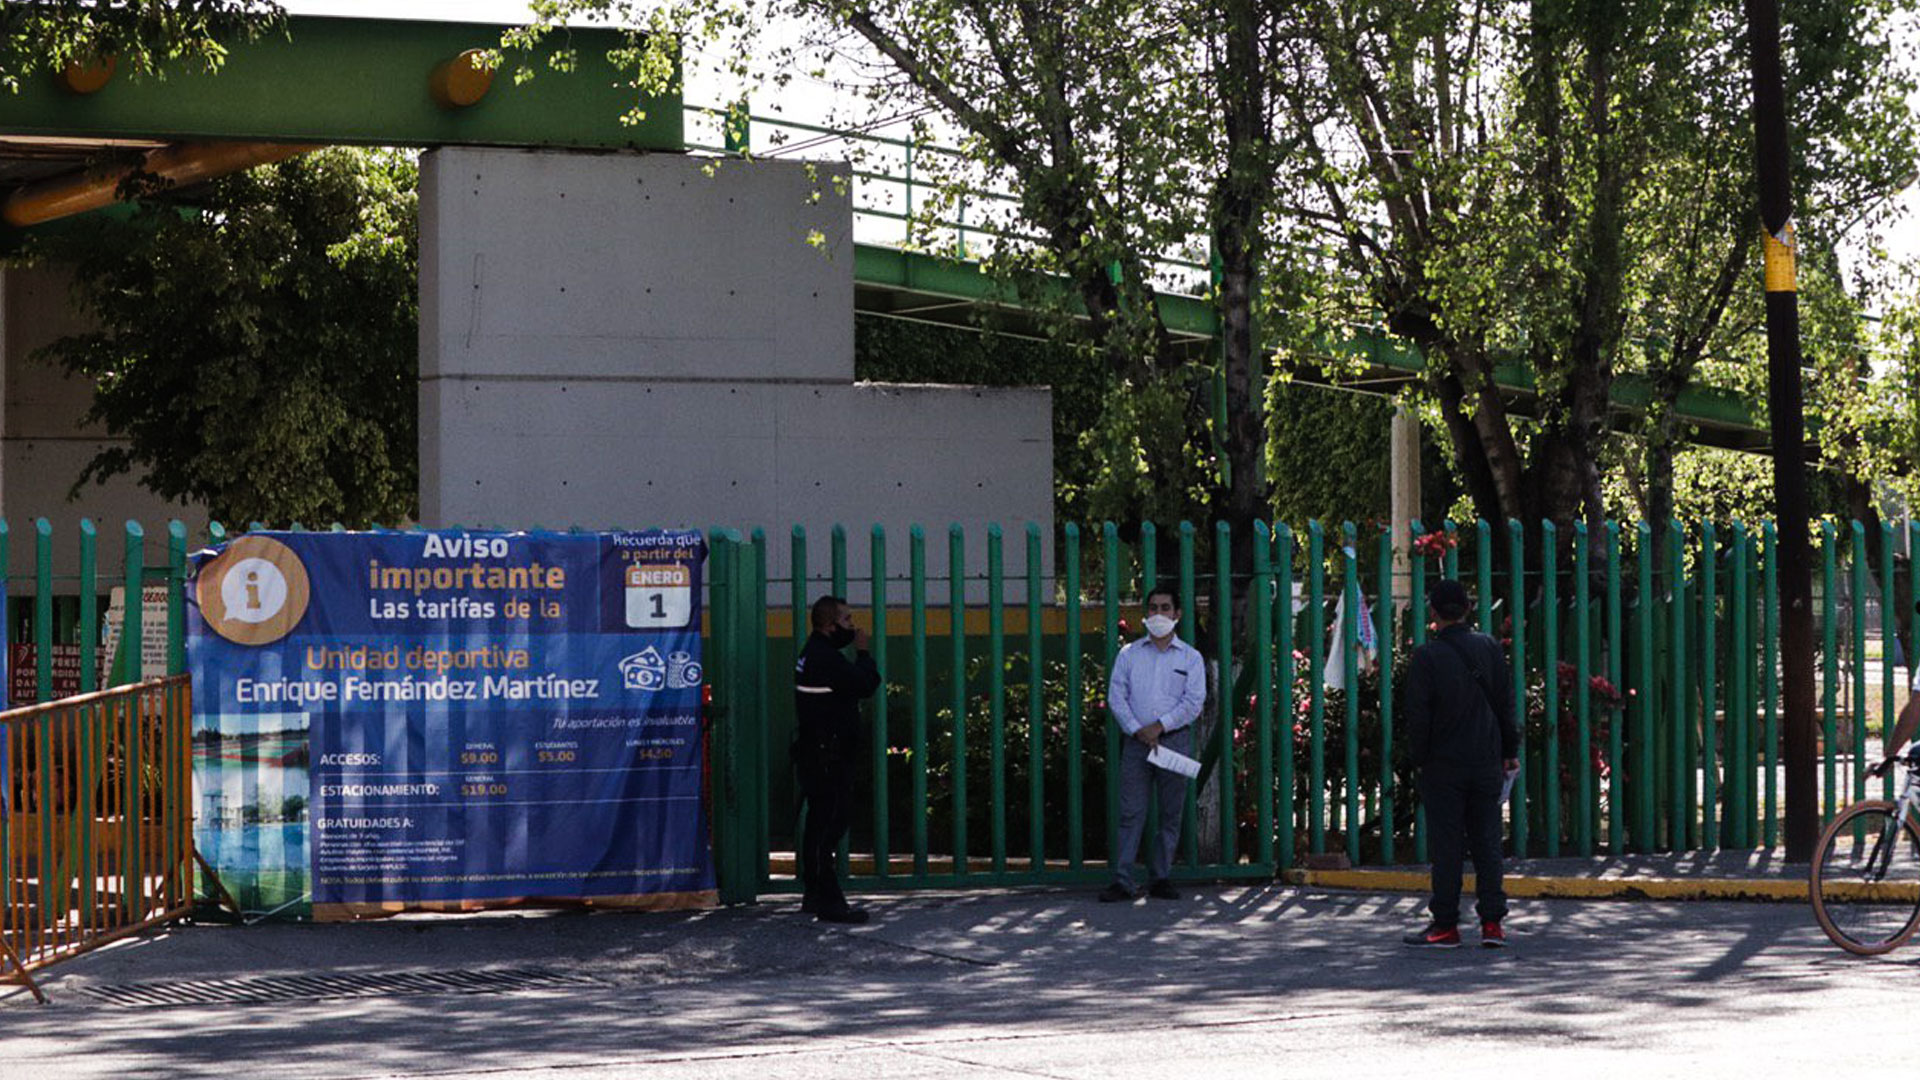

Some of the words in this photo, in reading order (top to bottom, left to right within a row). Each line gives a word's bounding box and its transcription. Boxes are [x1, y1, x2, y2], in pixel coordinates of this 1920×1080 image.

[422, 533, 509, 558] Aviso
[613, 534, 674, 548] Recuerda
[677, 536, 701, 551] que
[622, 551, 630, 561] a
[634, 549, 670, 562] partir
[673, 549, 694, 560] del
[369, 560, 566, 597] importante
[632, 571, 684, 585] ENERO
[370, 598, 410, 619] Las
[417, 597, 496, 619] tarifas
[504, 597, 531, 619] de
[540, 597, 561, 618] la
[649, 593, 667, 618] 1
[306, 646, 400, 670] Unidad
[405, 645, 530, 675] deportiva
[236, 677, 337, 706] Enrique
[345, 674, 477, 701] Fernández
[483, 674, 600, 699] Martínez
[320, 753, 382, 766] ACCESOS:
[320, 783, 441, 797] ESTACIONAMIENTO:
[318, 817, 401, 829] GRATUIDADES
[402, 817, 415, 828] A:
